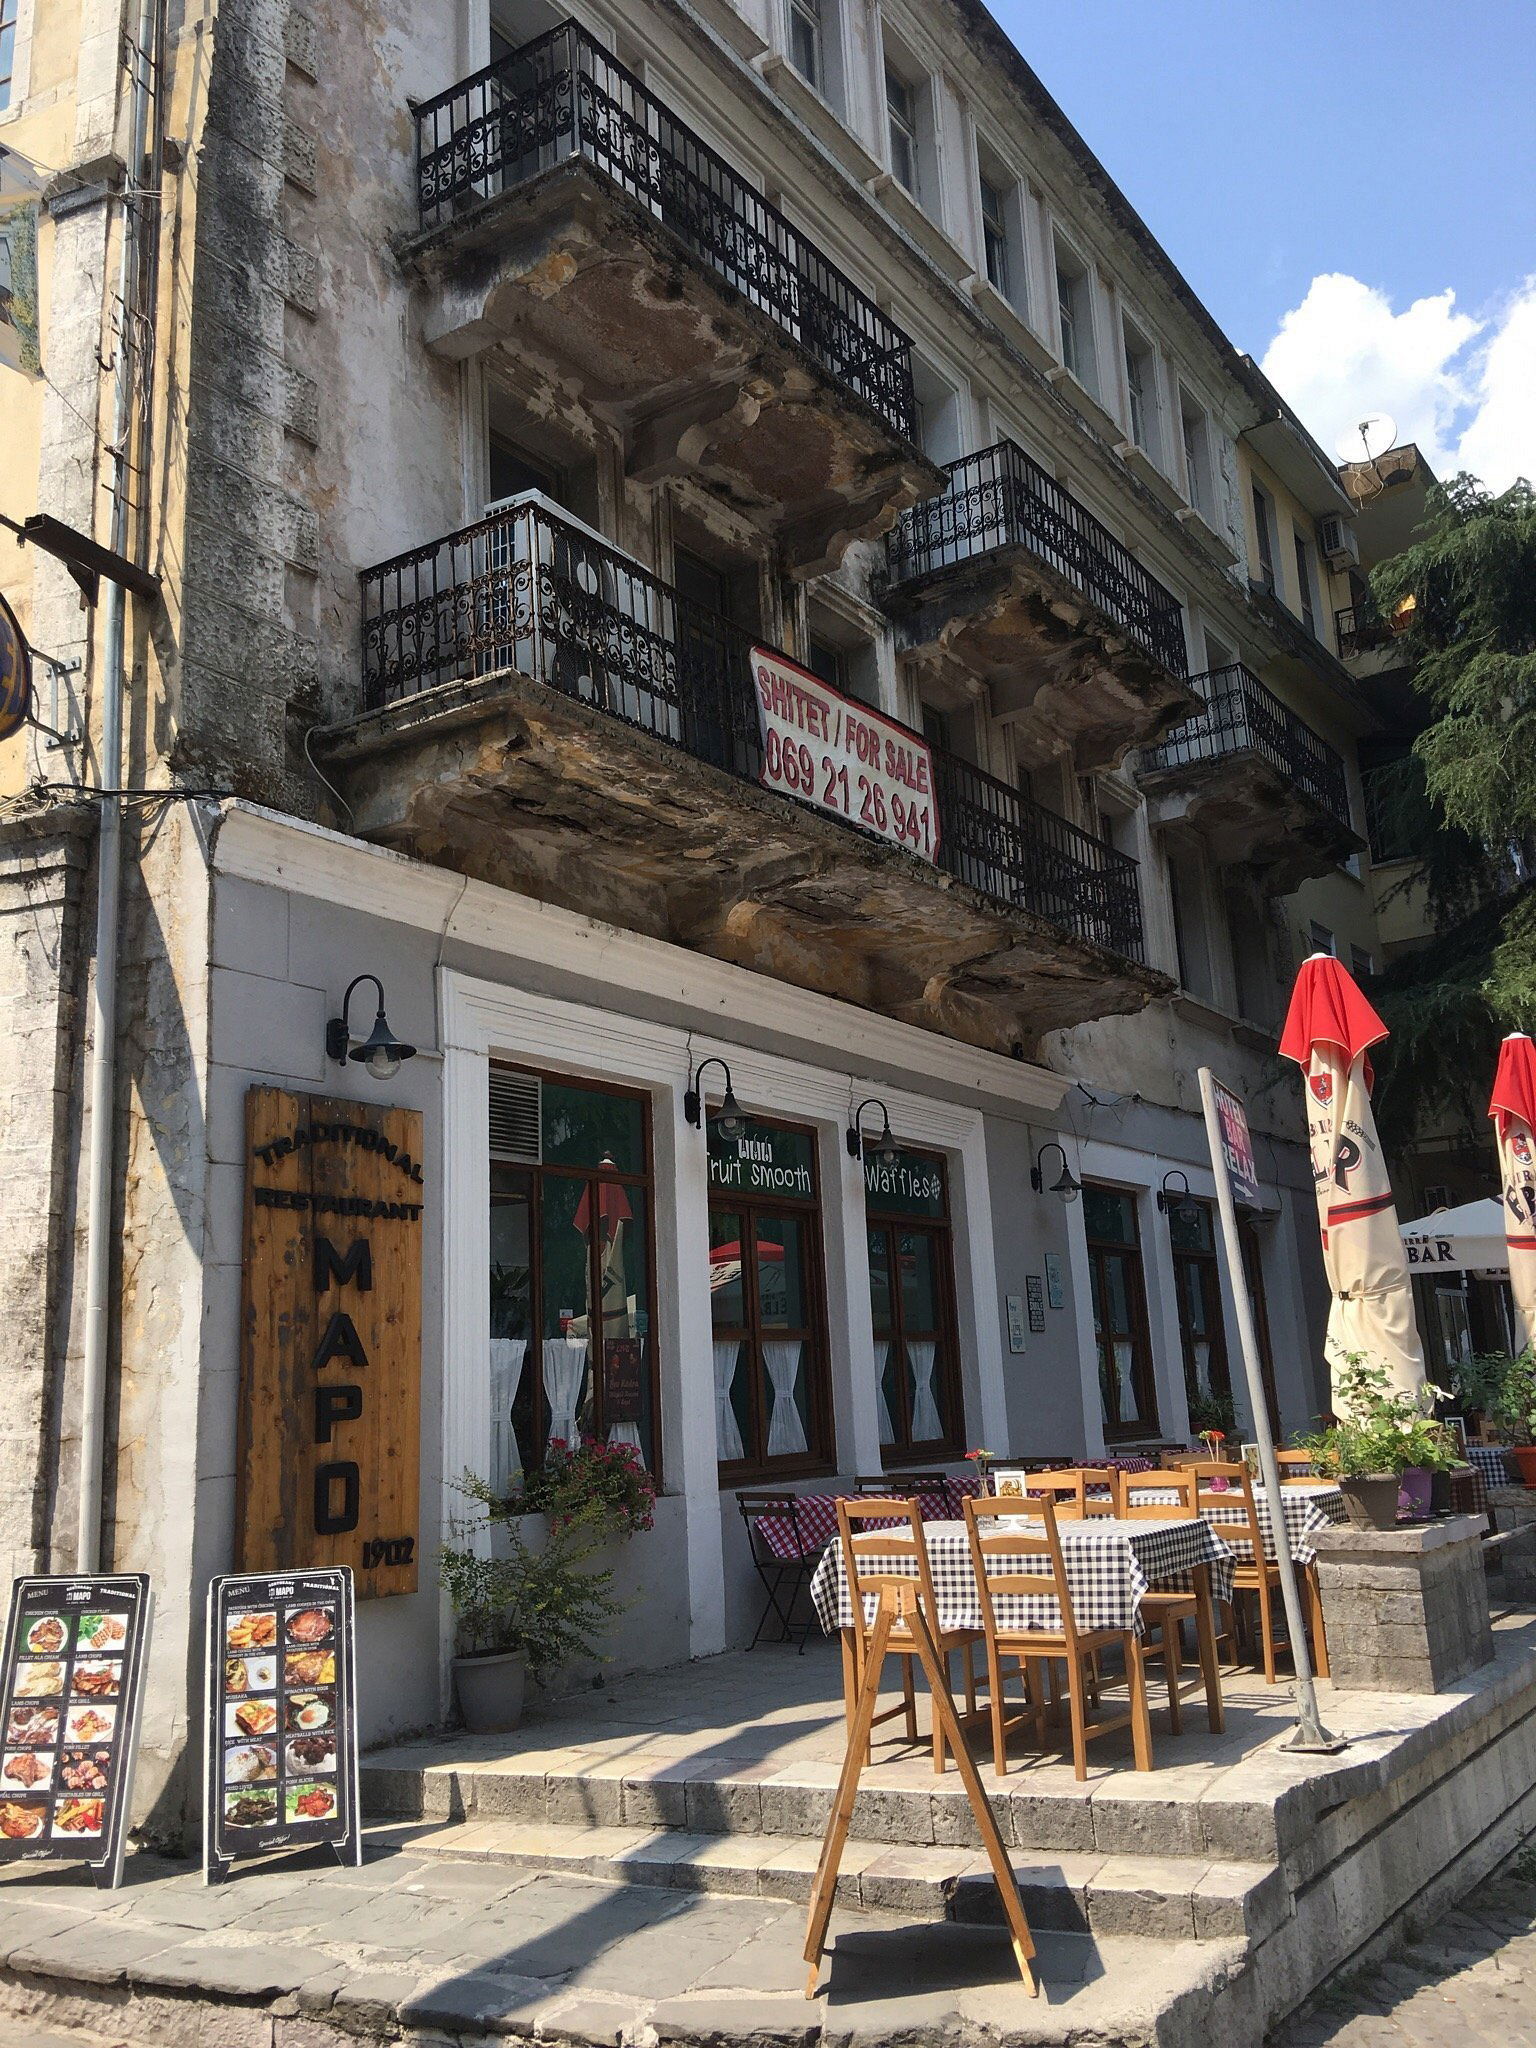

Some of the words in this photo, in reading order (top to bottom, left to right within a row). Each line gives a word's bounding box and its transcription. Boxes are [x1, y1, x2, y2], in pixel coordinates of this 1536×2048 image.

[758, 665, 830, 743] SHITET
[845, 714, 880, 771] FOR
[885, 739, 929, 795] SALE
[767, 727, 814, 797] 069
[822, 756, 849, 815] 21
[858, 774, 887, 832] 26
[891, 793, 930, 854] 941
[1224, 1115, 1247, 1153] BAR
[254, 1124, 424, 1184] TRADITIONAL
[709, 1156, 742, 1185] ruit
[751, 1163, 812, 1193] smooth
[865, 1163, 930, 1198] Waffles
[312, 1237, 373, 1536] MAPO
[362, 1536, 415, 1569] 1902
[27, 1589, 49, 1599] MENU
[73, 1591, 91, 1600] MAPO
[100, 1588, 136, 1598] TRADITIONAL
[227, 1586, 250, 1597] MENU
[275, 1586, 294, 1596] MAPO
[302, 1582, 340, 1591] TRADITIONAL
